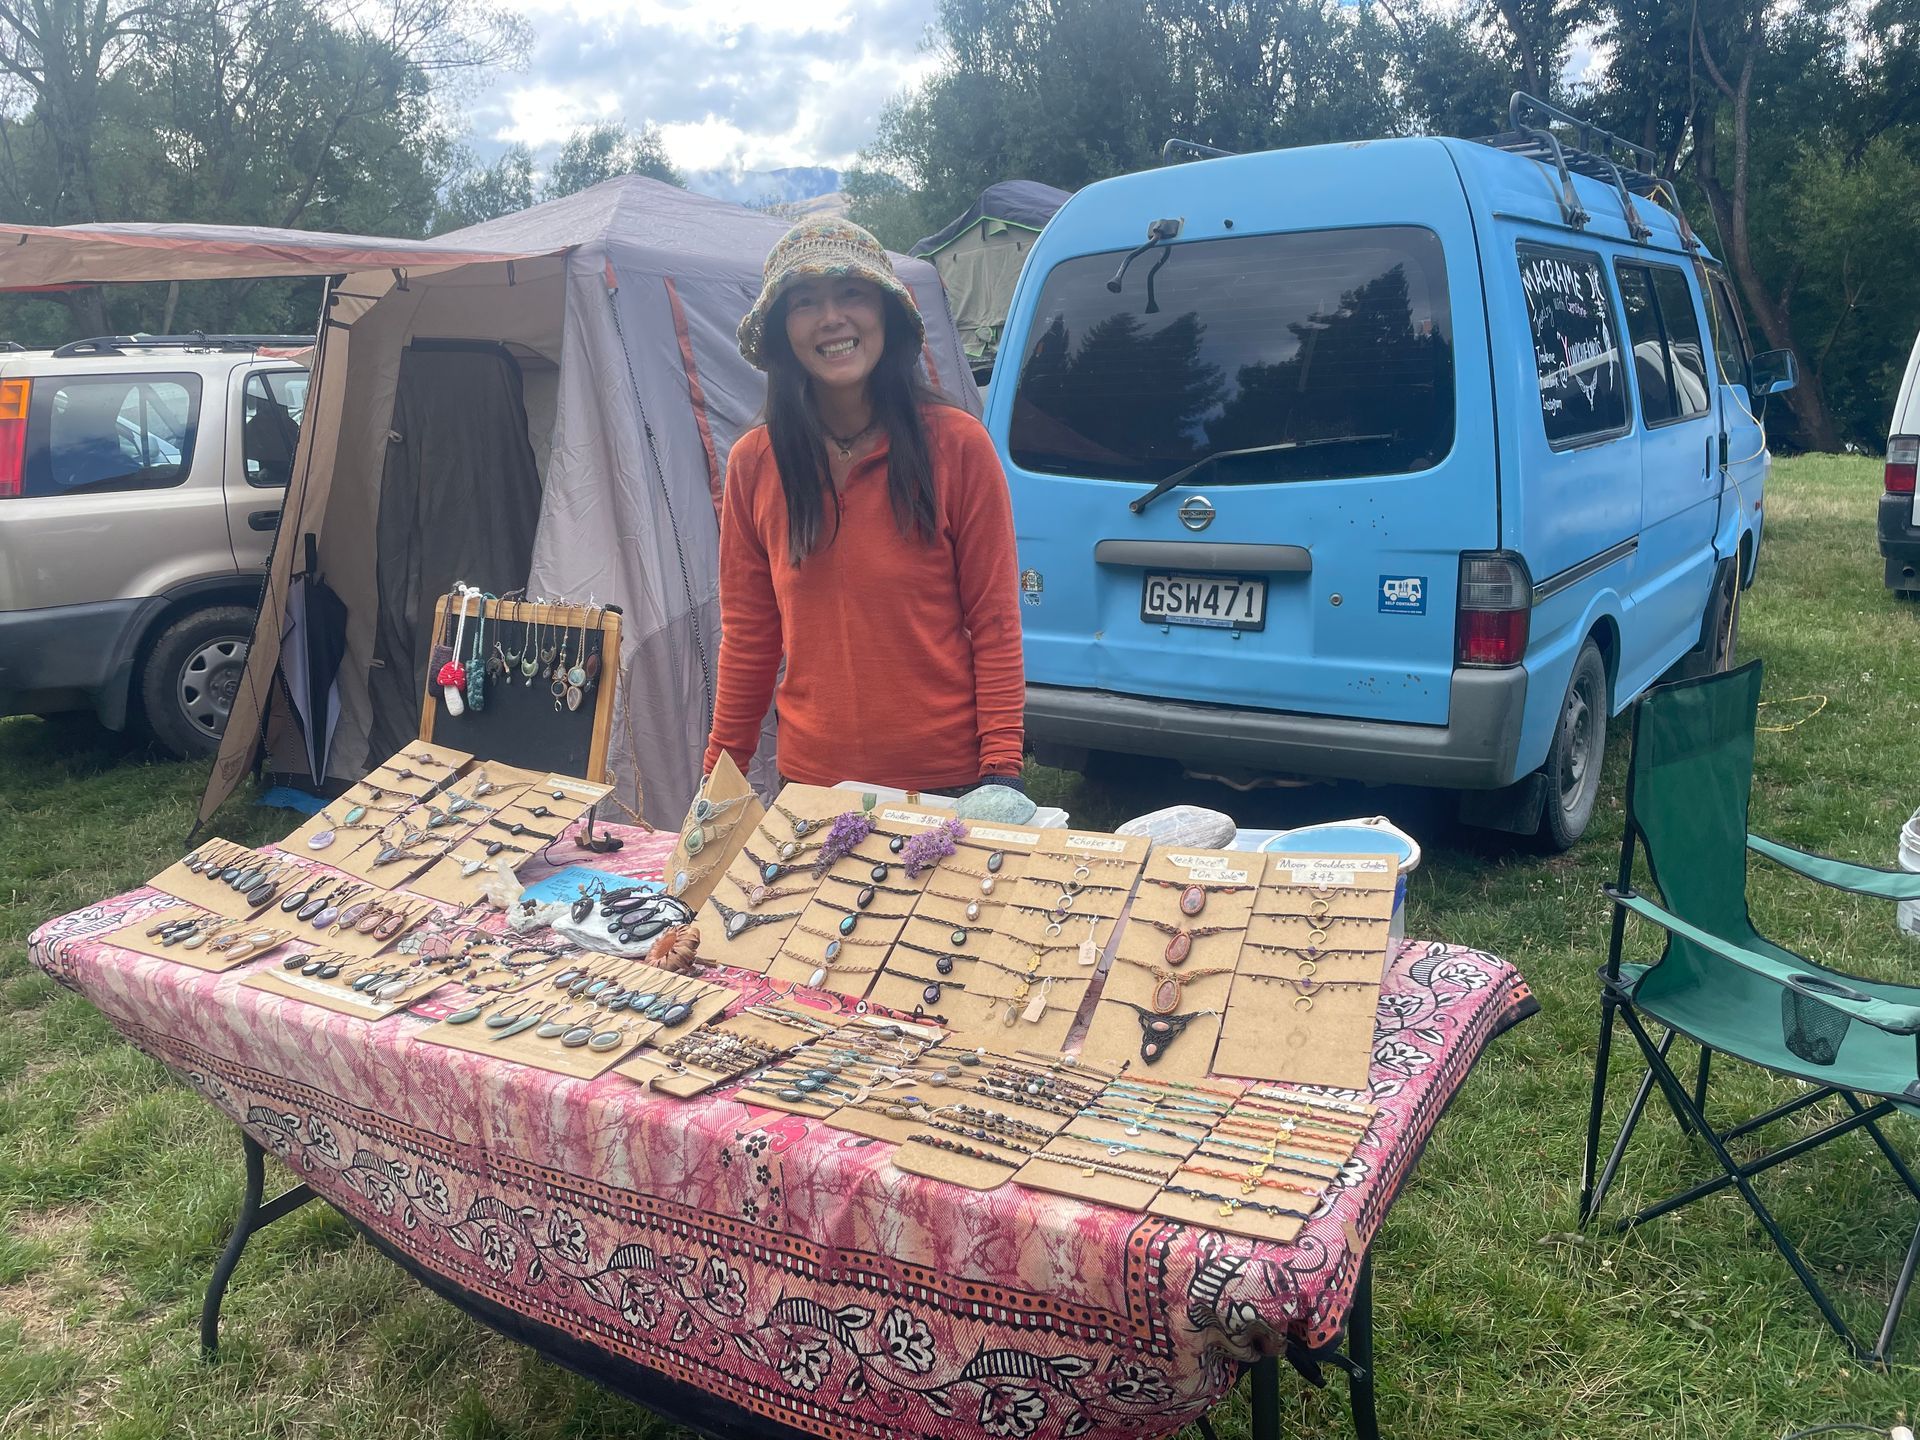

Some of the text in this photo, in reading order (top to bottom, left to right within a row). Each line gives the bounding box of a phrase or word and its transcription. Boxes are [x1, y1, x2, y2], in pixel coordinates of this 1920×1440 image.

[1522, 259, 1583, 309] MACRAME
[1149, 582, 1253, 617] GSW471
[1280, 860, 1306, 869] Moon
[1314, 860, 1356, 868] Goddess
[1310, 872, 1335, 882] $45
